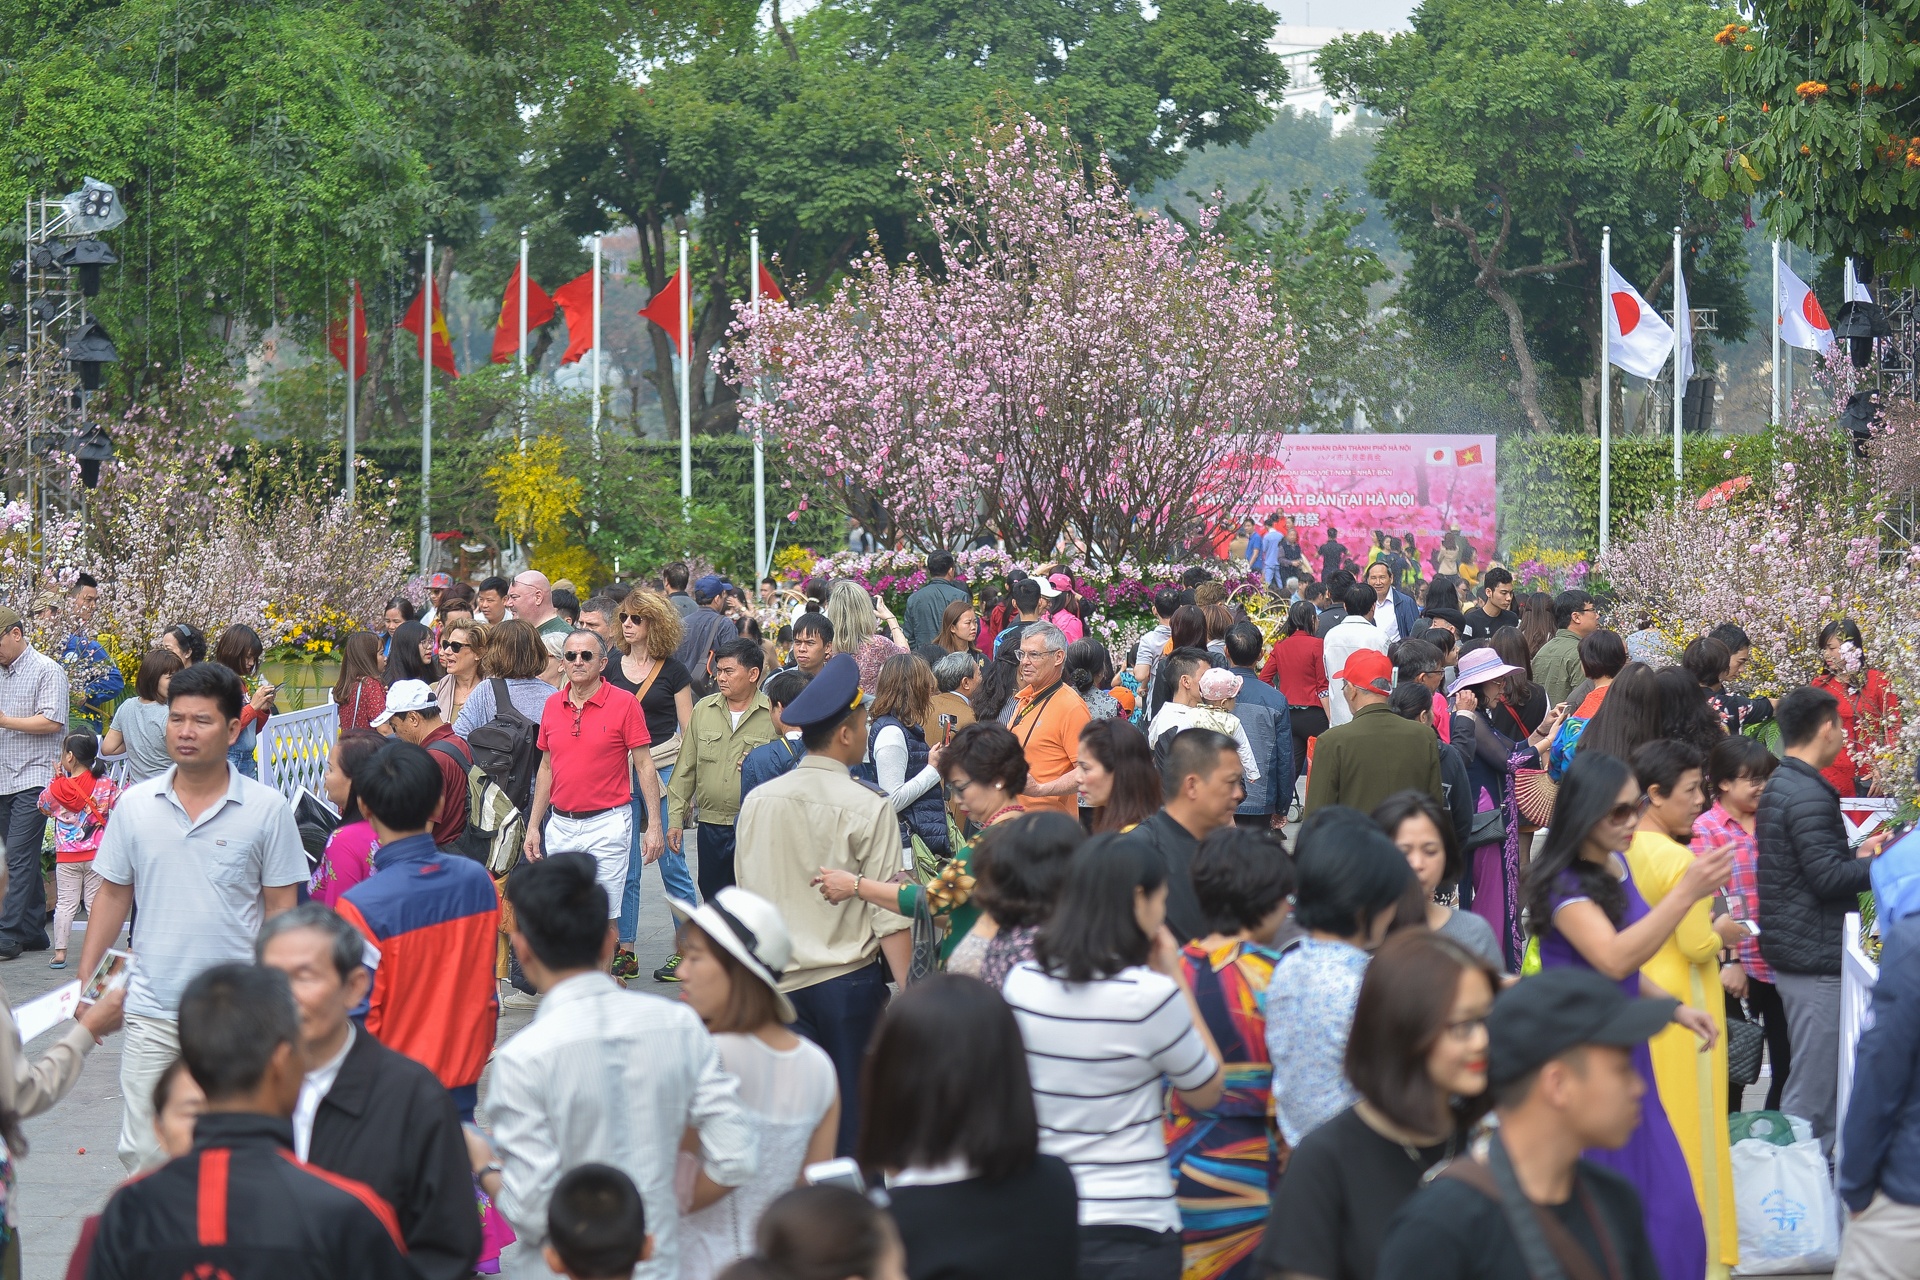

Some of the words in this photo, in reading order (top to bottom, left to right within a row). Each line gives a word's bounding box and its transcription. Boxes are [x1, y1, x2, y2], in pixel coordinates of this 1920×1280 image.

[1264, 492, 1303, 509] NHẬT
[1306, 492, 1337, 506] BẢN
[1340, 494, 1363, 509] TẠI
[1366, 491, 1386, 506] HÀ
[1389, 491, 1415, 509] NỘI
